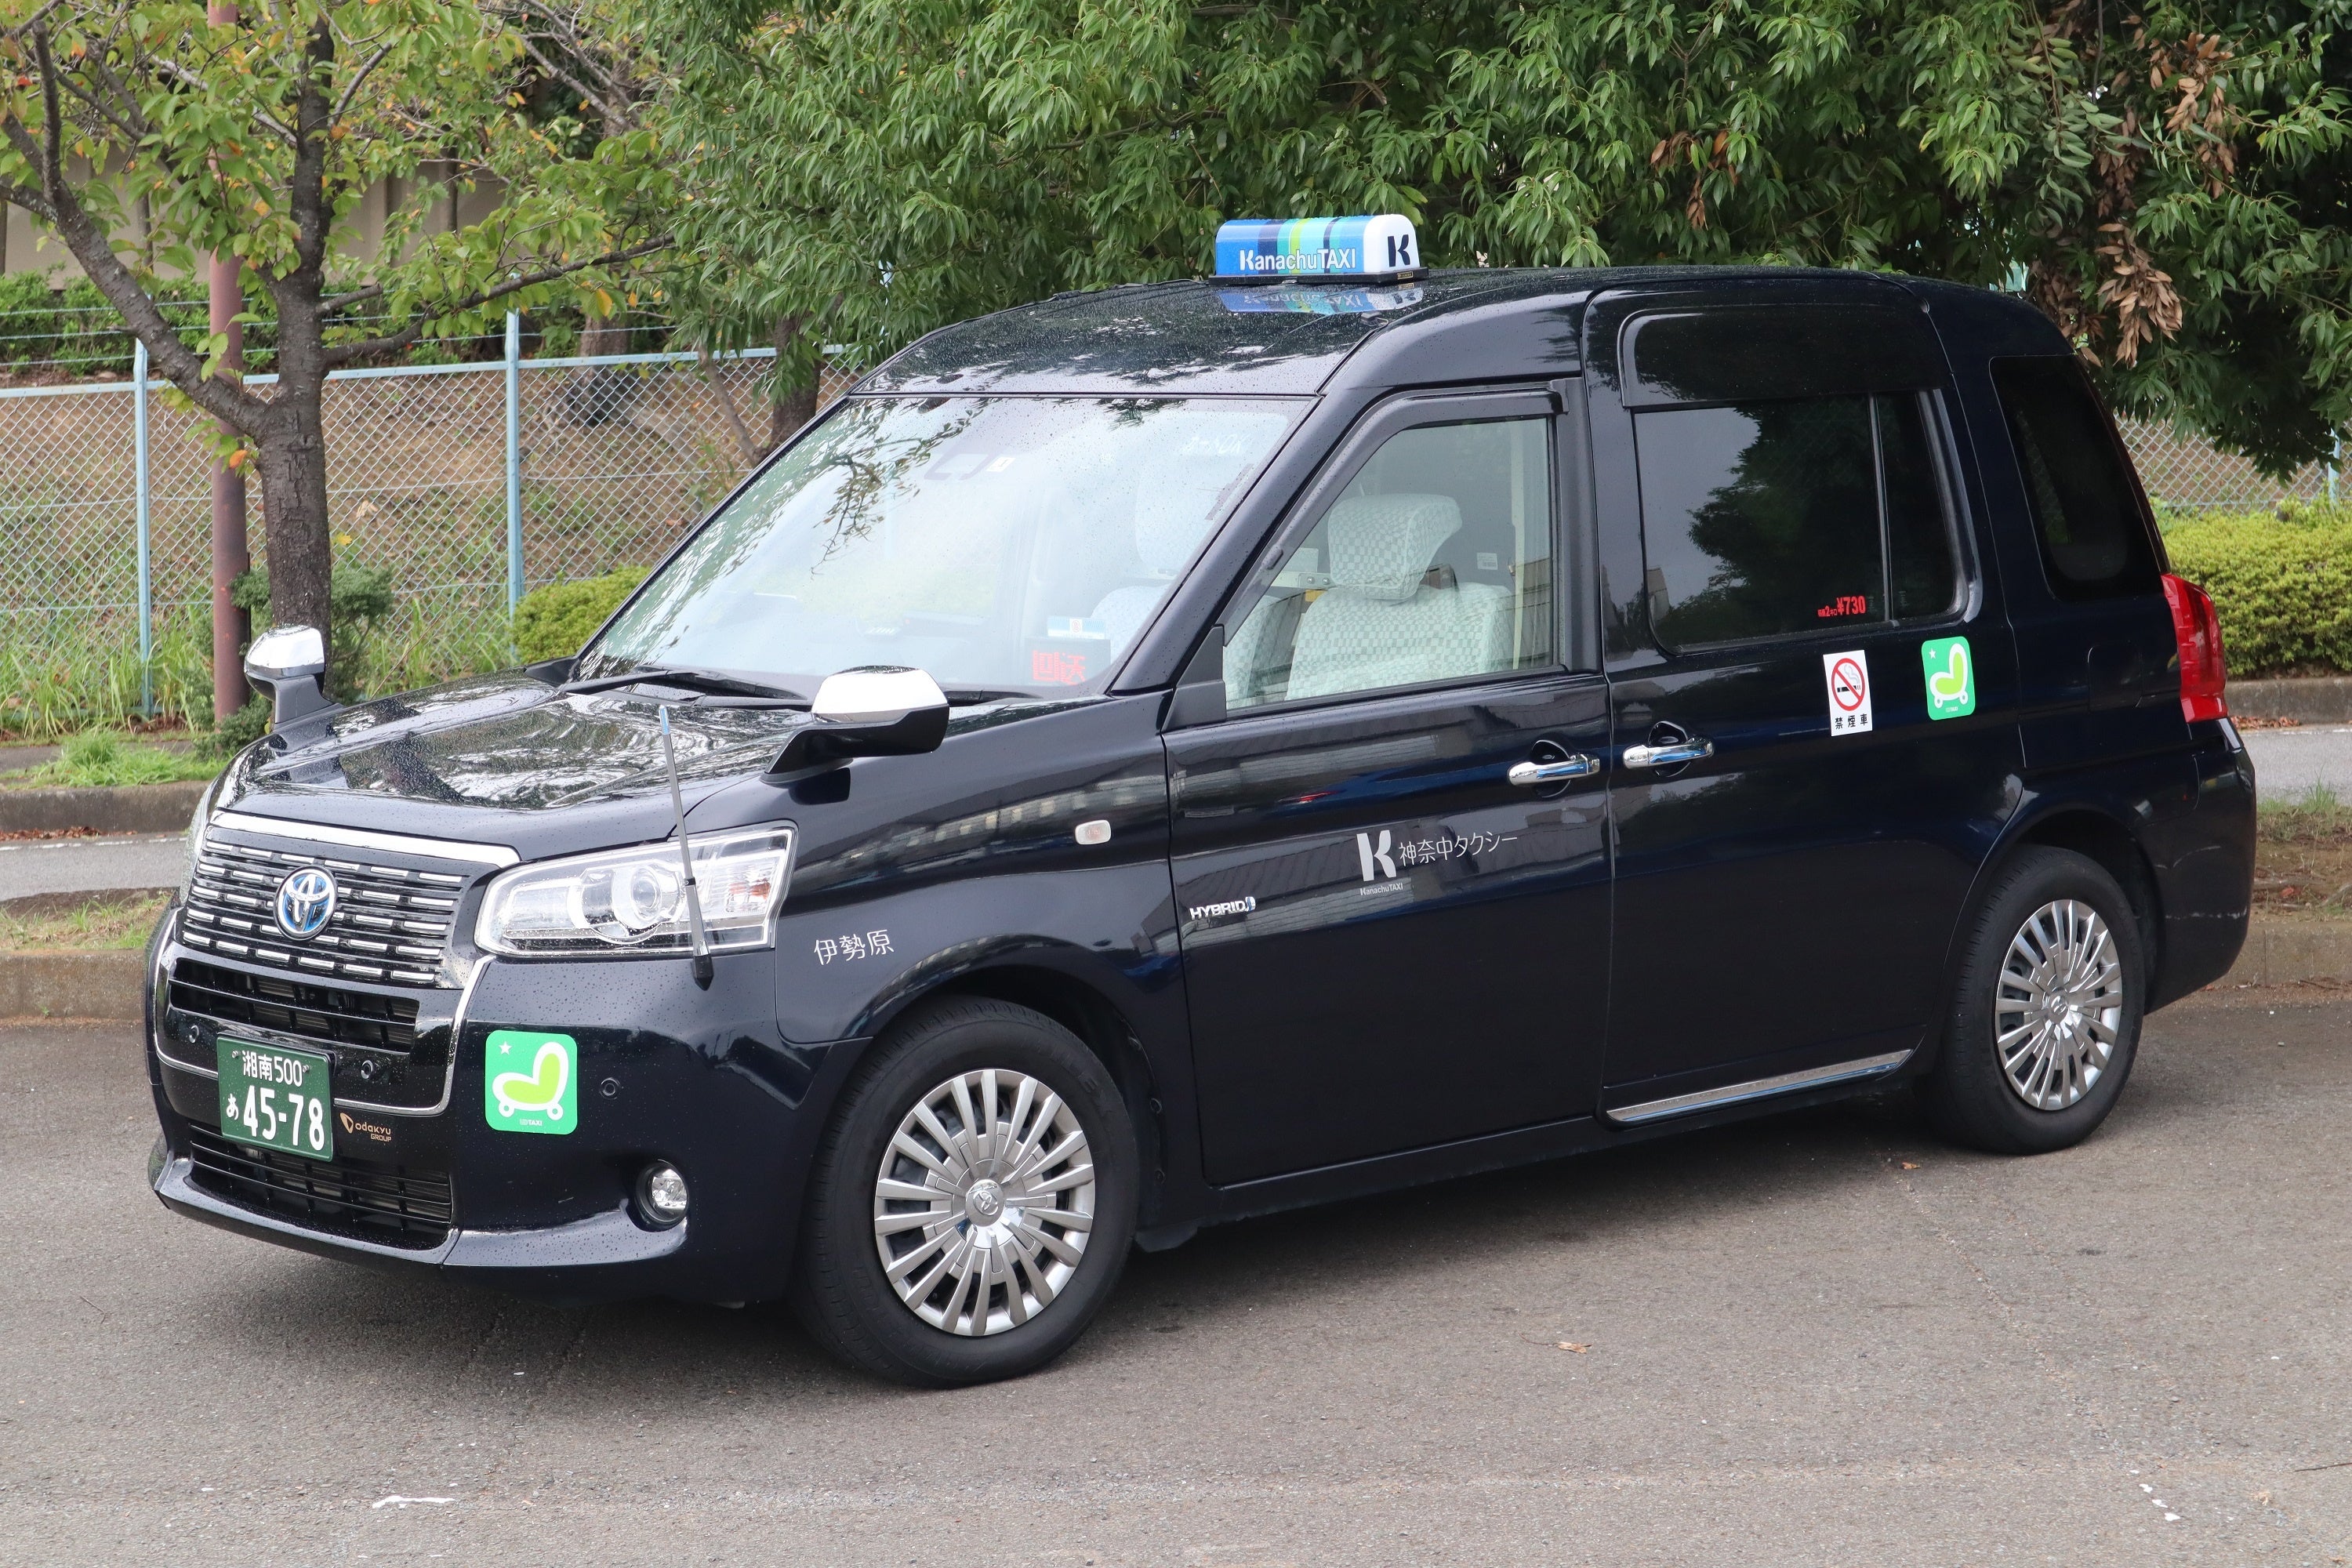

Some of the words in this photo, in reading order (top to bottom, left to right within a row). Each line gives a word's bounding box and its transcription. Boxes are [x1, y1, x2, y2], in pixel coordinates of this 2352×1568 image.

[1240, 248, 1356, 270] KanachuTAXI
[1387, 234, 1411, 267] K
[1836, 596, 1866, 615] ¥730
[1033, 650, 1087, 686] 回送
[1835, 713, 1868, 729] 禁煙車
[1356, 829, 1397, 882] K
[1399, 831, 1518, 867] 神奈中タクシー
[1359, 883, 1403, 896] KanachuTAXI
[1189, 900, 1247, 920] HYBRID
[814, 929, 895, 966] 伊勢原
[226, 1093, 239, 1120] あ
[243, 1085, 325, 1151] 45-78
[370, 1133, 392, 1142] GROUP
